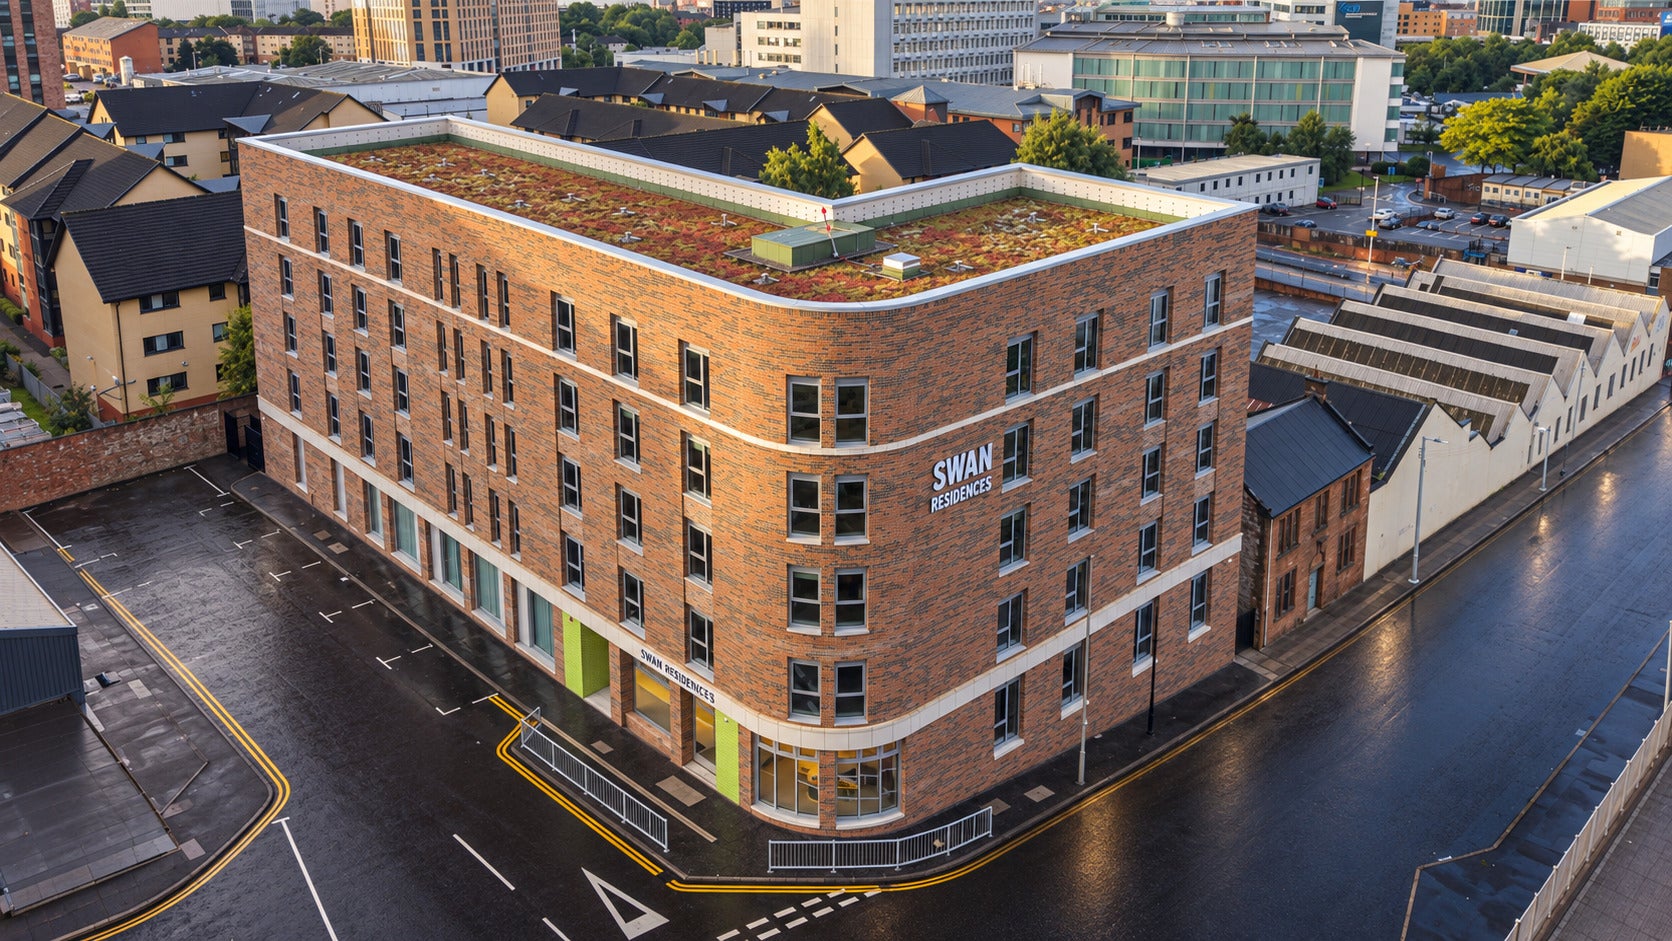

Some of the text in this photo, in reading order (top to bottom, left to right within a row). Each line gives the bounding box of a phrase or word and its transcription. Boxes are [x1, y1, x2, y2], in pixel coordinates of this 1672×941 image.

[933, 442, 993, 491] SWAN
[931, 475, 992, 513] RESIDENCES
[641, 649, 715, 704] SWAN RESIDENCES
